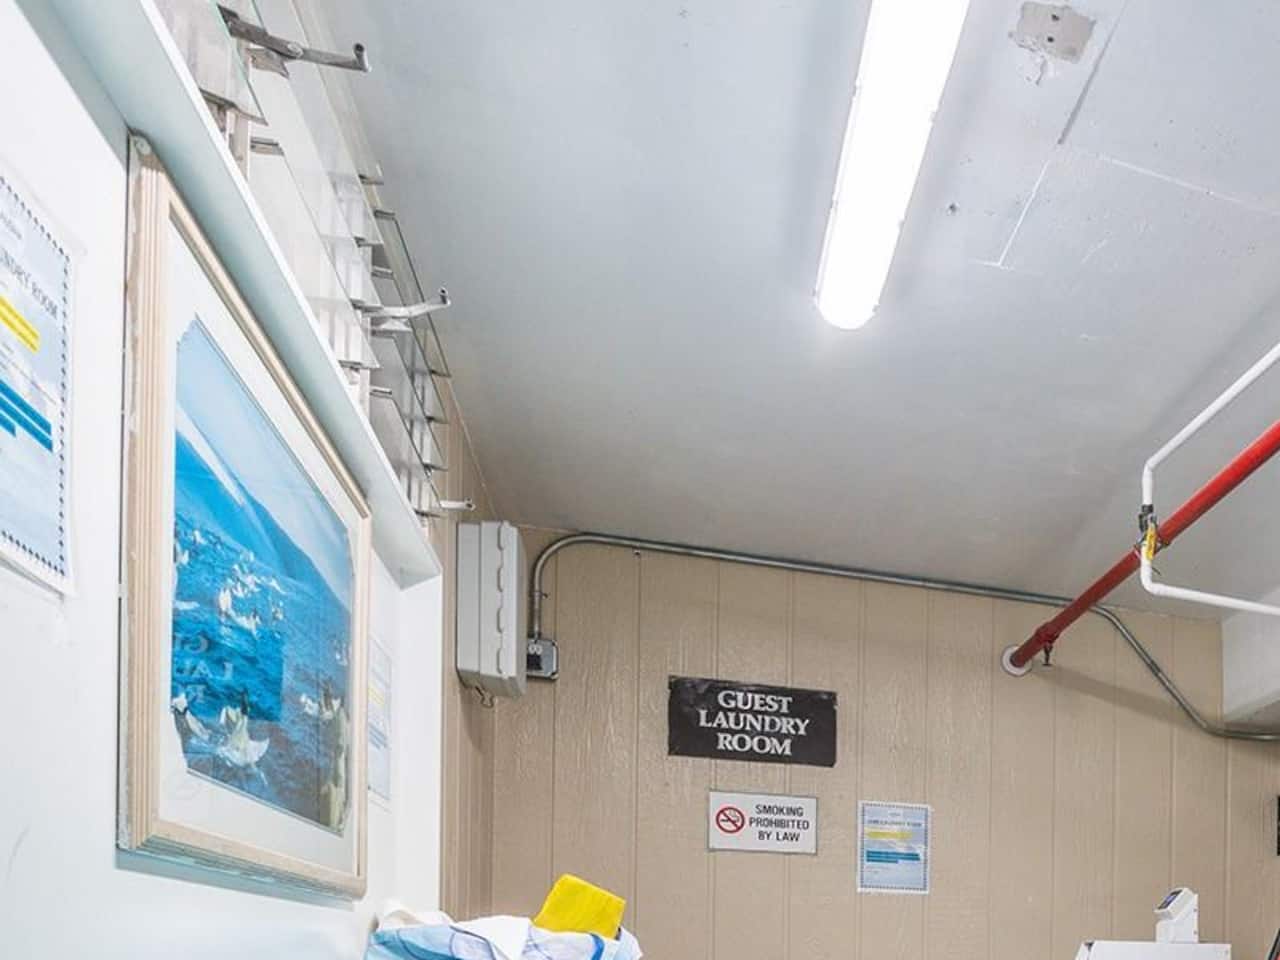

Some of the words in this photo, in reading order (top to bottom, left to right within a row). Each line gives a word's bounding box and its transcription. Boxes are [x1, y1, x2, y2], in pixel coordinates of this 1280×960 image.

[717, 690, 792, 713] GUEST
[699, 709, 810, 736] LAUNDRY
[716, 732, 792, 756] ROOM
[755, 804, 803, 817] SMOKING
[749, 816, 810, 830] PROHIBITED
[758, 830, 772, 841] BY
[776, 831, 800, 842] LAW
